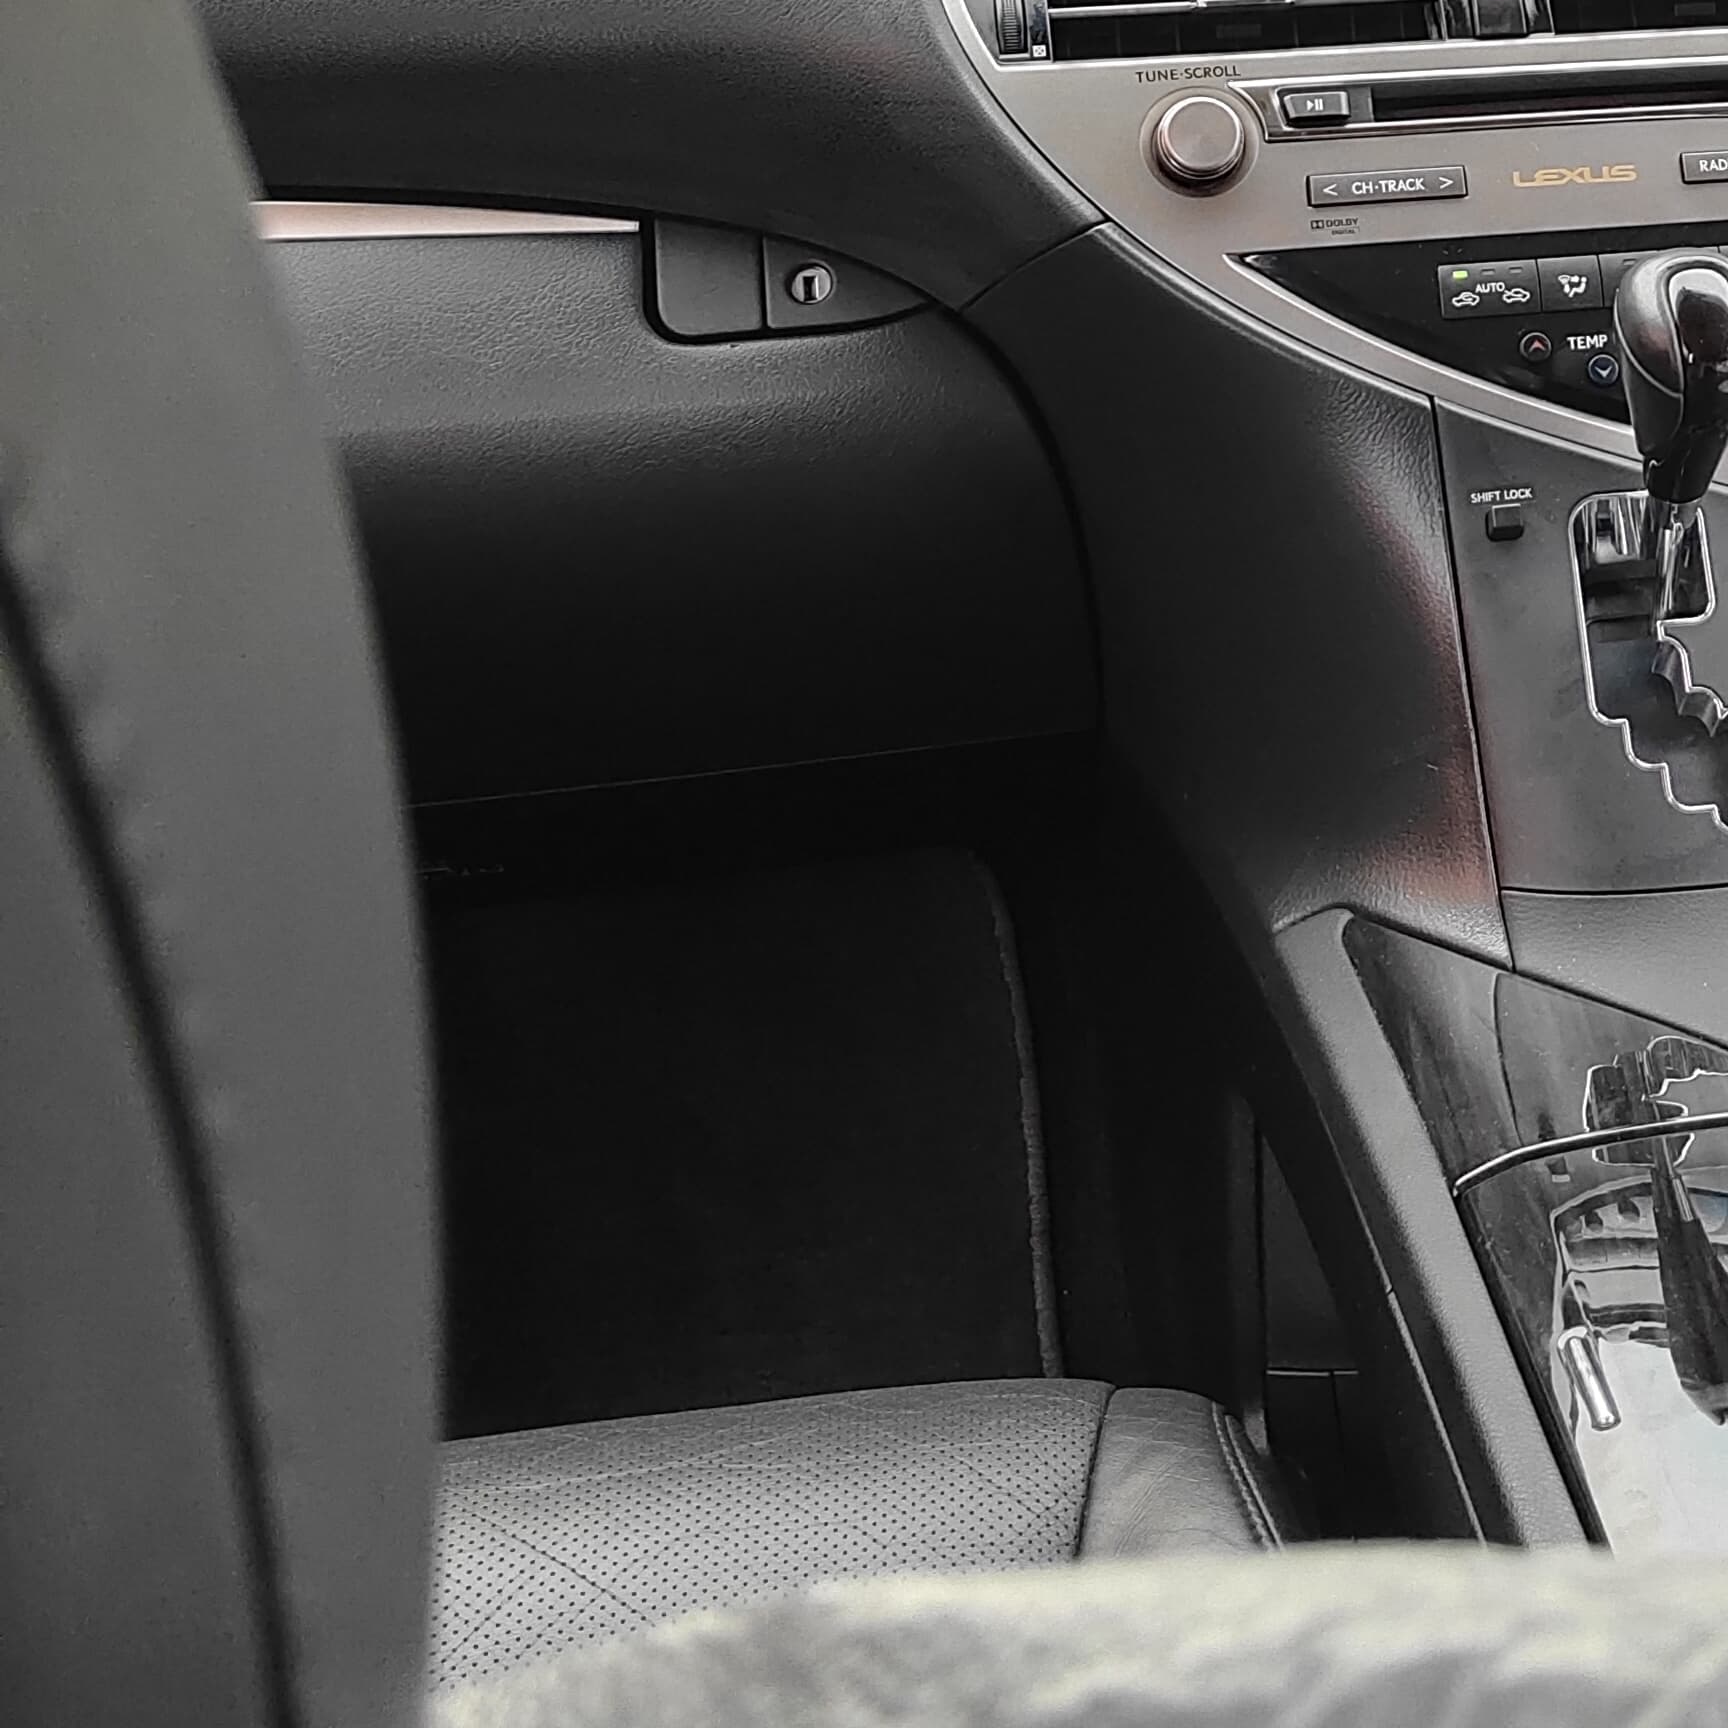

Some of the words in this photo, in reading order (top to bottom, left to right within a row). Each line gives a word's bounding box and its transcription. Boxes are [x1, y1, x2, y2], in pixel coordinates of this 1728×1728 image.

[1512, 164, 1637, 187] LEXUS
[1325, 218, 1358, 229] DOLBY
[1475, 281, 1505, 293] AUTO
[1567, 333, 1608, 350] TEMP
[1470, 490, 1501, 504] SHIFT
[1504, 487, 1533, 501] LOCK
